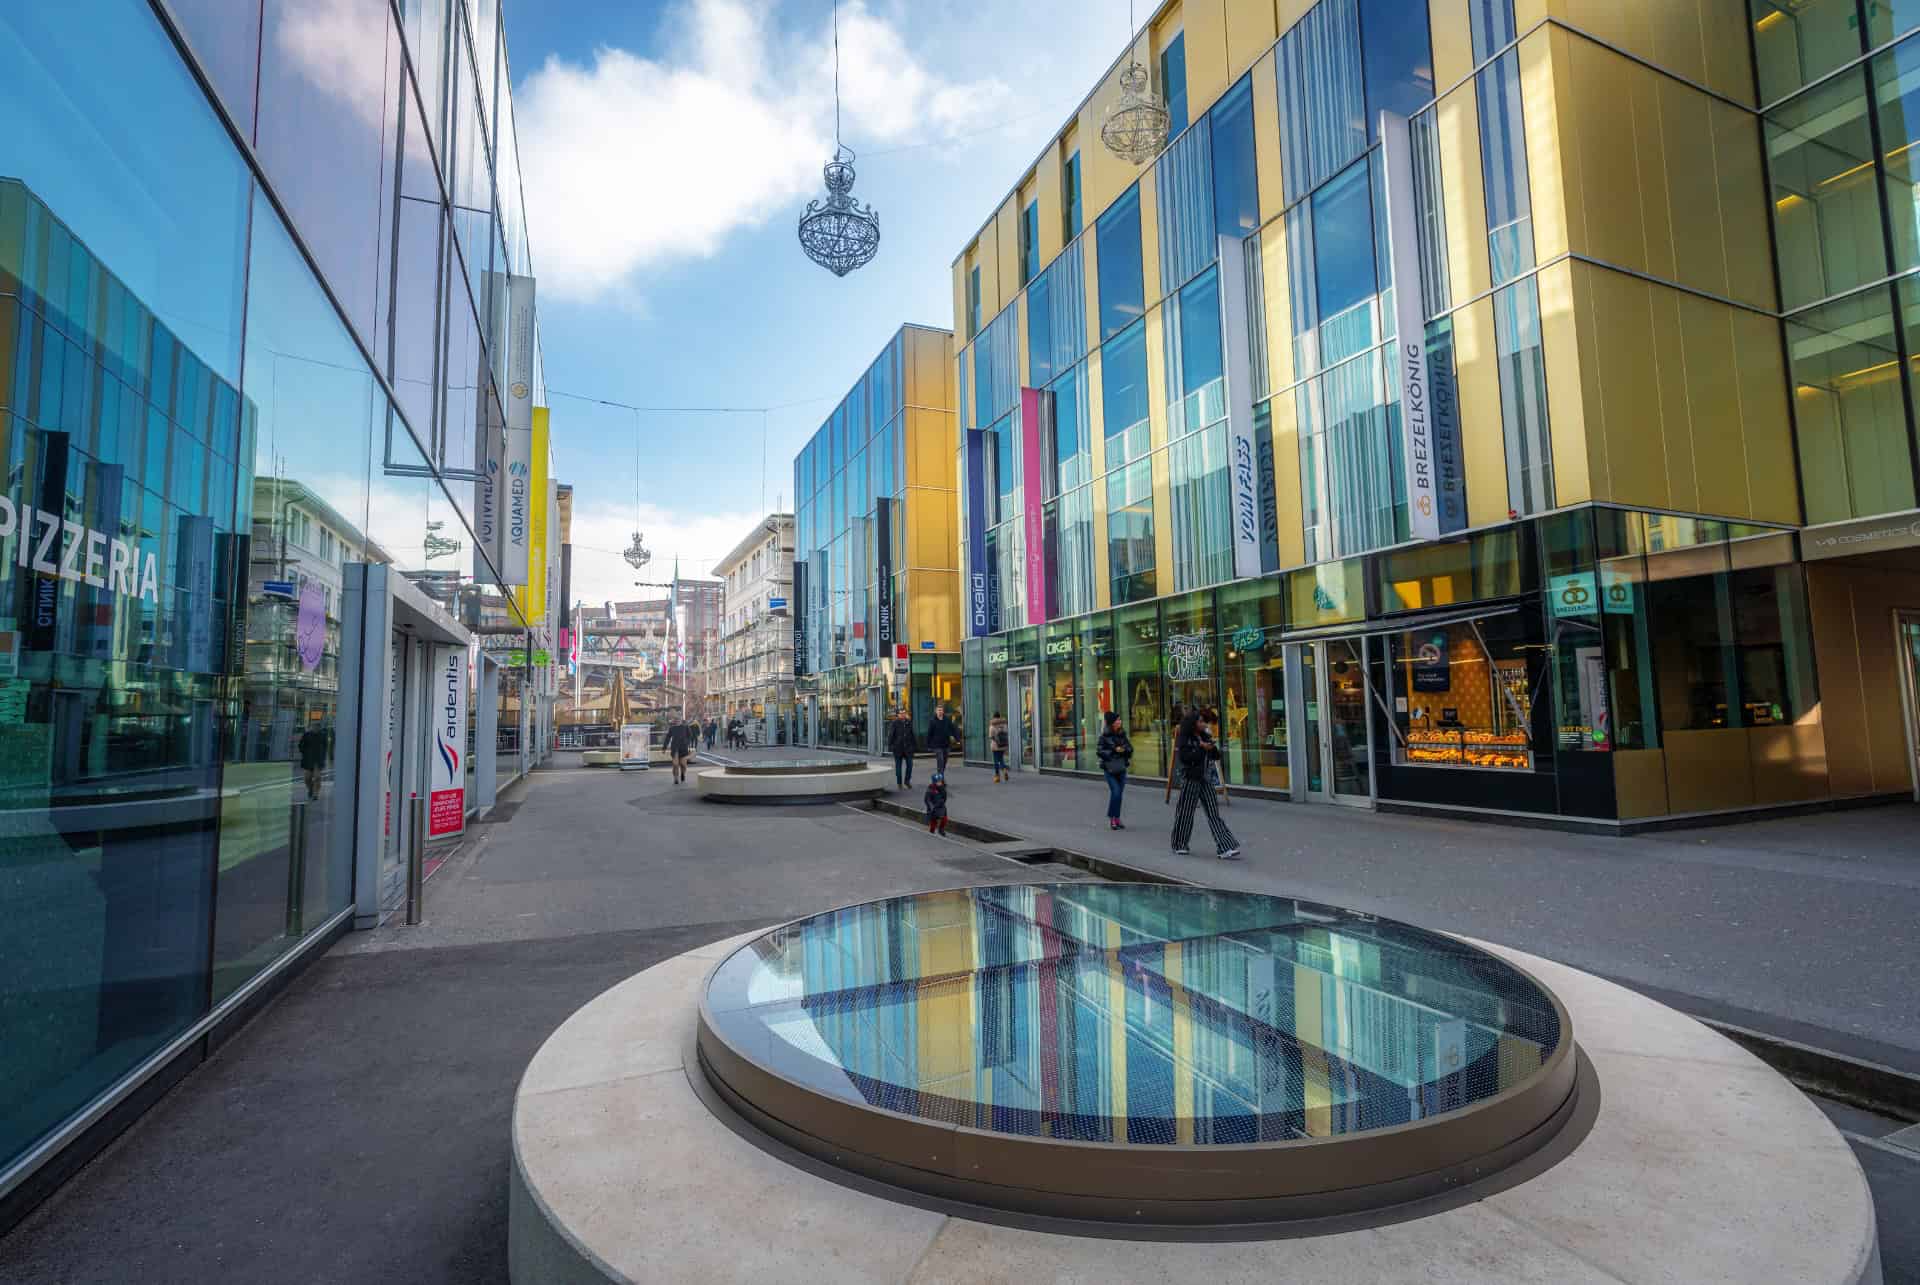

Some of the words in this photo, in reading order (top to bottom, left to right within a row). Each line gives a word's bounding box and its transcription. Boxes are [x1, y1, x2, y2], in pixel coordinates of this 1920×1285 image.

[1408, 343, 1430, 489] BREZELKÖNIG
[0, 496, 158, 604] PIZZERIA
[512, 478, 524, 545] AQUAMED
[446, 655, 458, 738] ardentis
